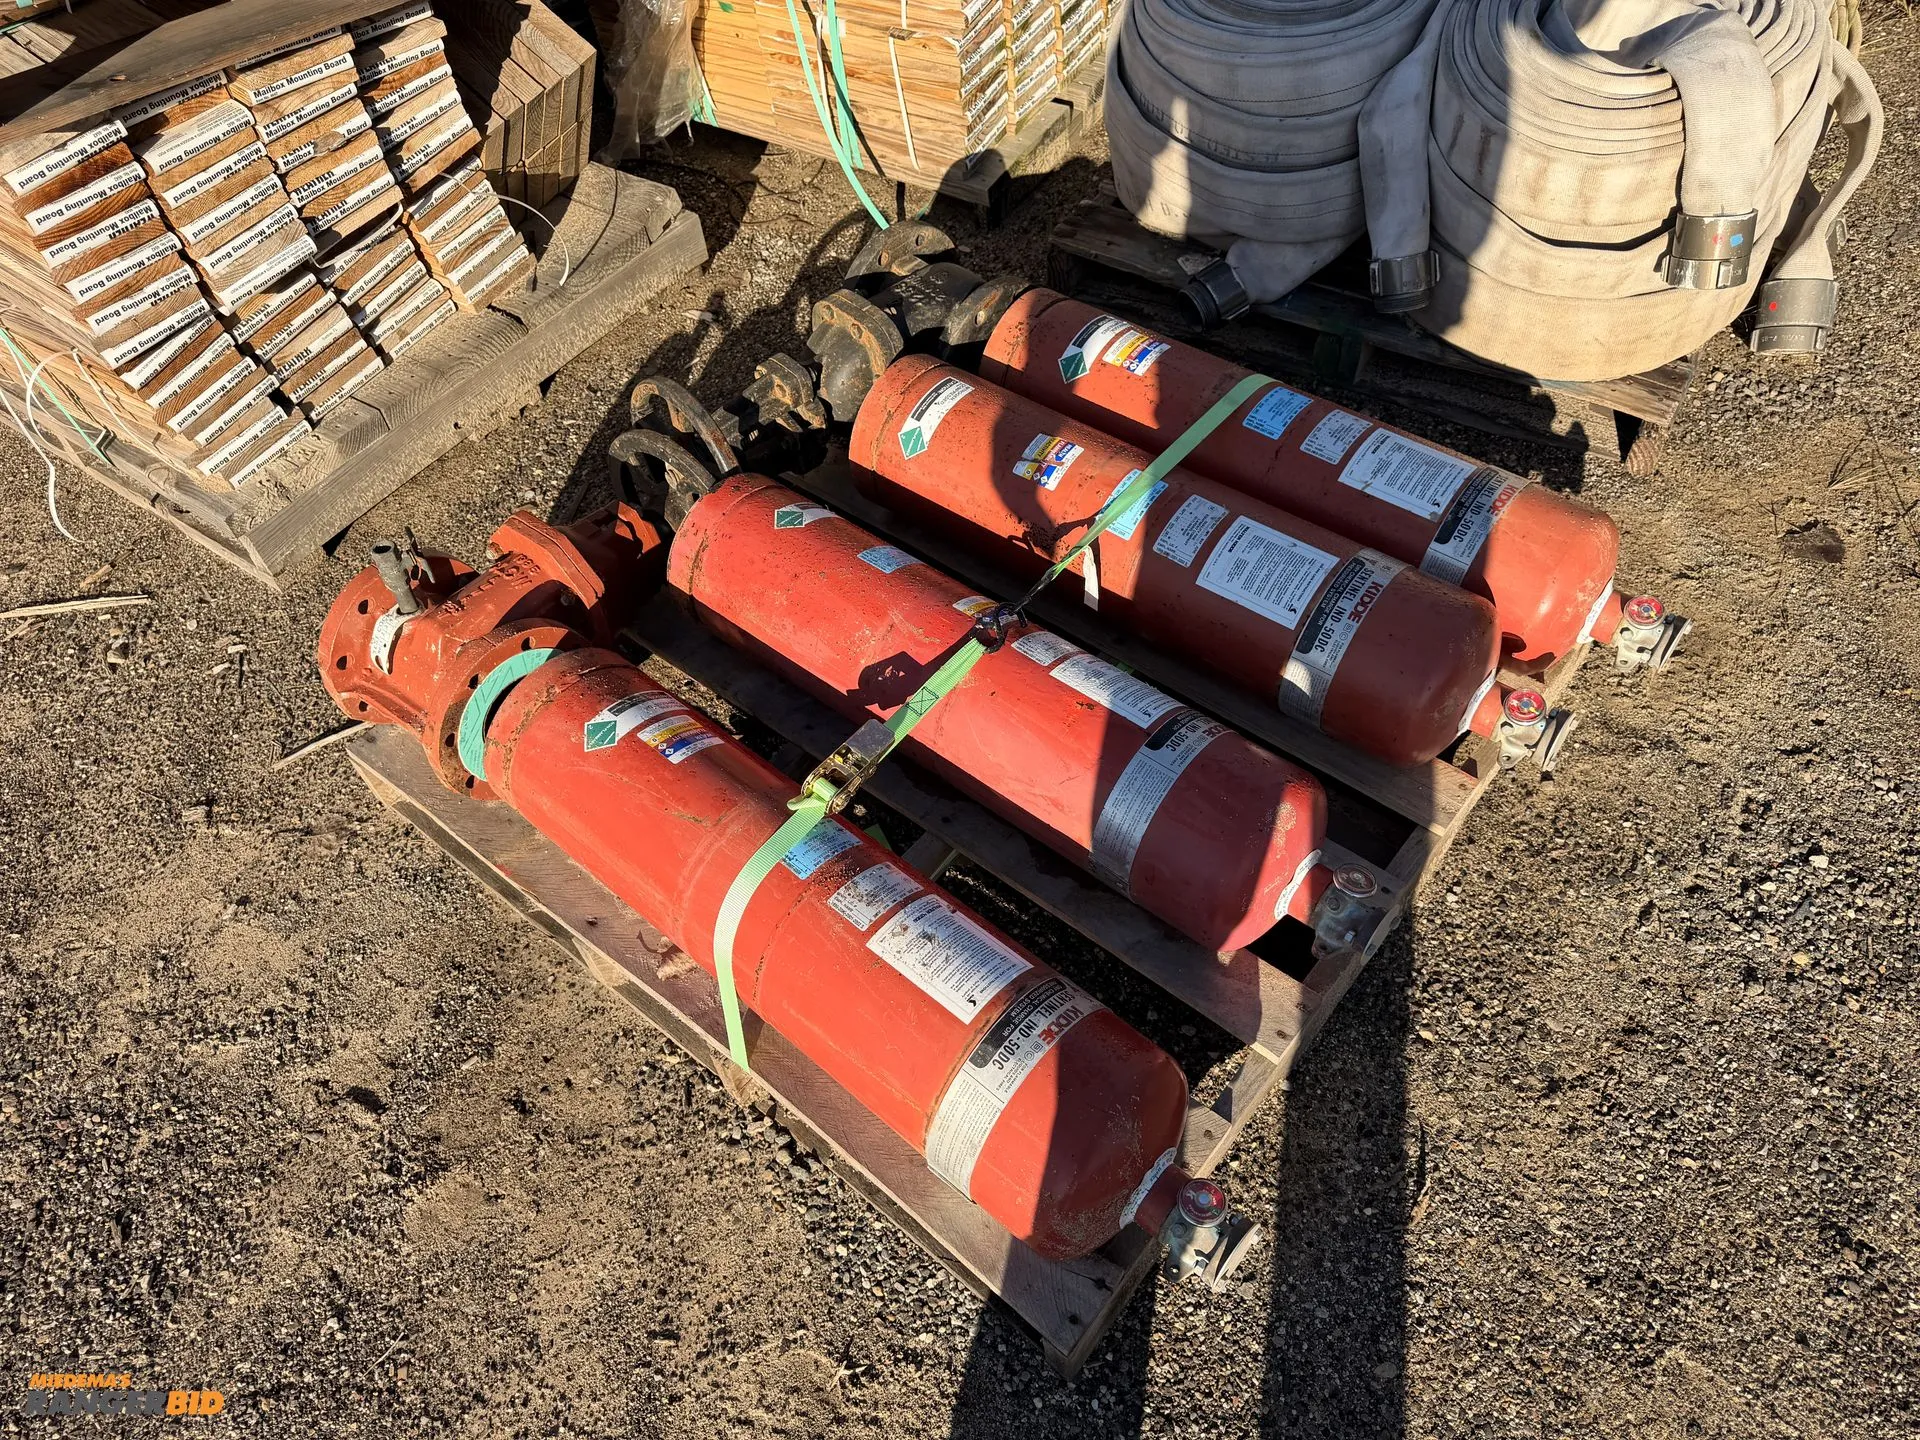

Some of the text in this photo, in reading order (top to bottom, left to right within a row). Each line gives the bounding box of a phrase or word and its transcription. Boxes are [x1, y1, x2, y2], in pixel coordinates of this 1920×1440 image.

[370, 5, 426, 32] Mounting Board
[252, 55, 347, 98] Mailbox Mounting Board
[359, 43, 440, 82] Mailbox Mounting Board
[121, 73, 222, 124] Mailbox Mounting Board
[264, 87, 352, 138] Mailbox Mounting Board
[370, 69, 448, 114] Mailbox Mounting Board
[158, 118, 252, 171] Mailbox Mounting Board
[281, 119, 367, 167] Mailbox Board
[381, 97, 458, 147] Mailbox Mounting Board
[397, 122, 469, 176] Mailbox Mounting Board
[17, 126, 122, 190] Mailbox Mounting Board
[172, 146, 262, 204] Mailbox Mounting Board
[296, 153, 379, 203] Mailbox Mounting Board
[34, 172, 142, 226] Mailbox Mounting Board
[191, 181, 279, 240] Mailbox Mounting Board
[311, 179, 391, 233] Mailbox Mounting Board
[48, 205, 152, 259] Mailbox Mounting Board
[209, 208, 294, 269] Mailbox Mounting Board
[78, 242, 177, 298] Mailbox Mounting Board
[347, 244, 411, 302] Mailbox Mounting Board
[94, 273, 191, 327] Mailbox Mounting Board
[236, 277, 312, 338] Mailbox Mounting Board
[261, 297, 333, 357] Mailbox Mounting Board
[113, 304, 206, 364] Mailbox Mounting Board
[157, 342, 233, 408] Mailbox Mounting Board
[176, 362, 252, 429] Mailbox Mounting Board
[208, 413, 284, 474] Mailbox Mounting Board
[236, 427, 310, 485] Mailbox Mounting Board
[1453, 500, 1486, 543] IND-50DC
[1312, 566, 1375, 654] SENTINEL IND-50DC
[1316, 562, 1361, 626] DRY CHEMICAL CHARGE FOR
[1319, 560, 1356, 609] PRESSURIZED SYSTEM
[1346, 579, 1383, 624] KIDDE
[1008, 996, 1031, 1018] SYSTEM
[1011, 1003, 1034, 1025] CHARGE
[1031, 986, 1055, 1006] CHEMICAL
[990, 990, 1075, 1071] SENTINEL IND-50DC
[1000, 1022, 1015, 1038] FOR
[1038, 1005, 1084, 1047] KIDDE
